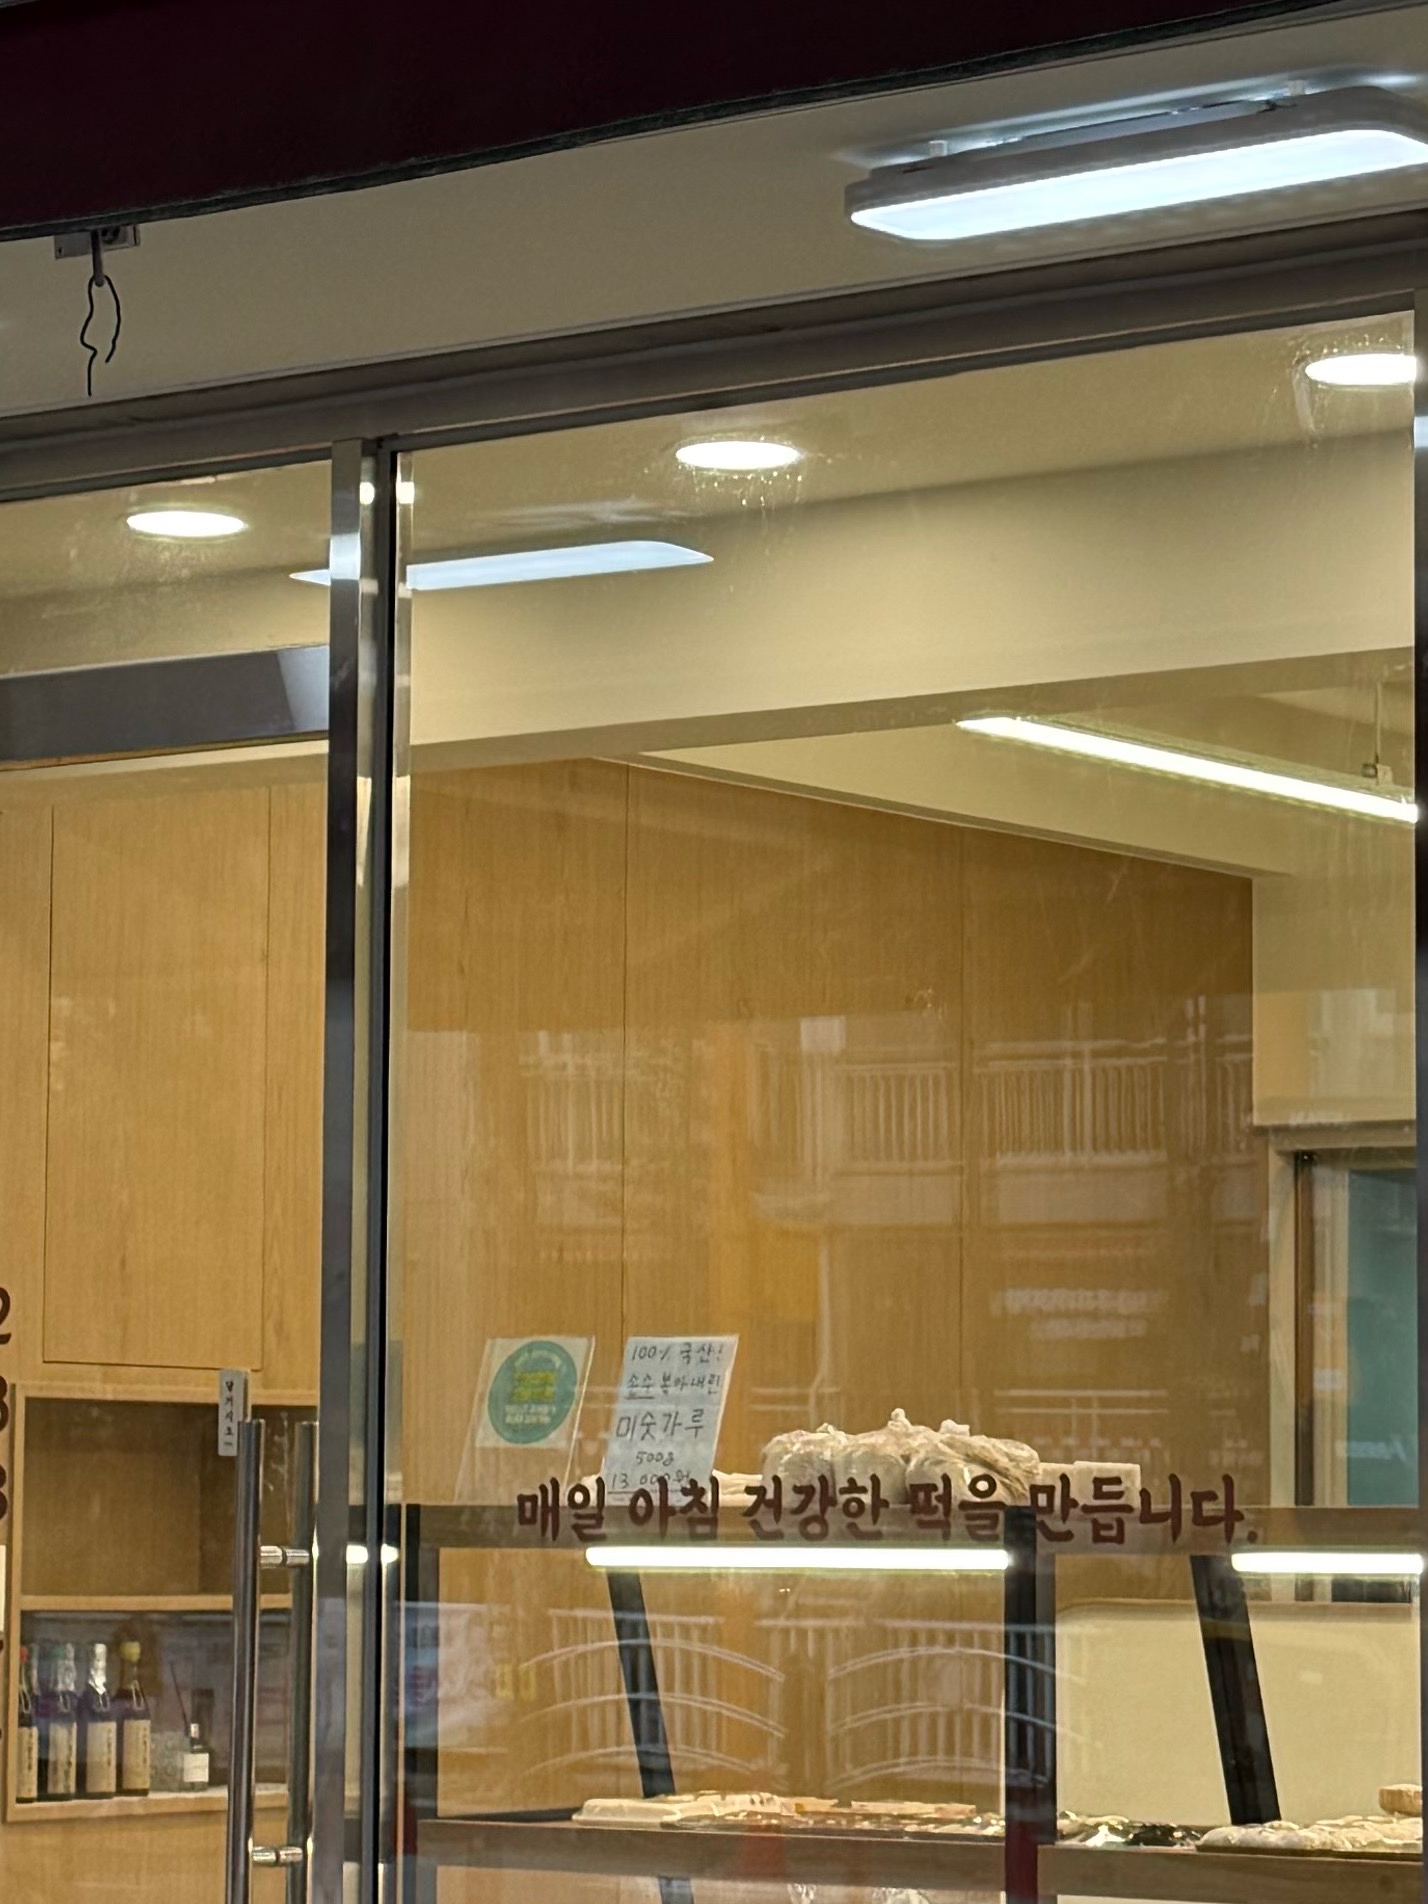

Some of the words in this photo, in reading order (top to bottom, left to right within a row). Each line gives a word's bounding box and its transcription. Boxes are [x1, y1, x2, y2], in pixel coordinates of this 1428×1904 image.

[615, 1408, 705, 1442] 미숫가루
[517, 1476, 606, 1542] 매일
[629, 1475, 719, 1540] 아침
[742, 1474, 890, 1542] 건강한
[909, 1473, 1008, 1542] 떡을
[1028, 1473, 1259, 1546] 만듭니다.
